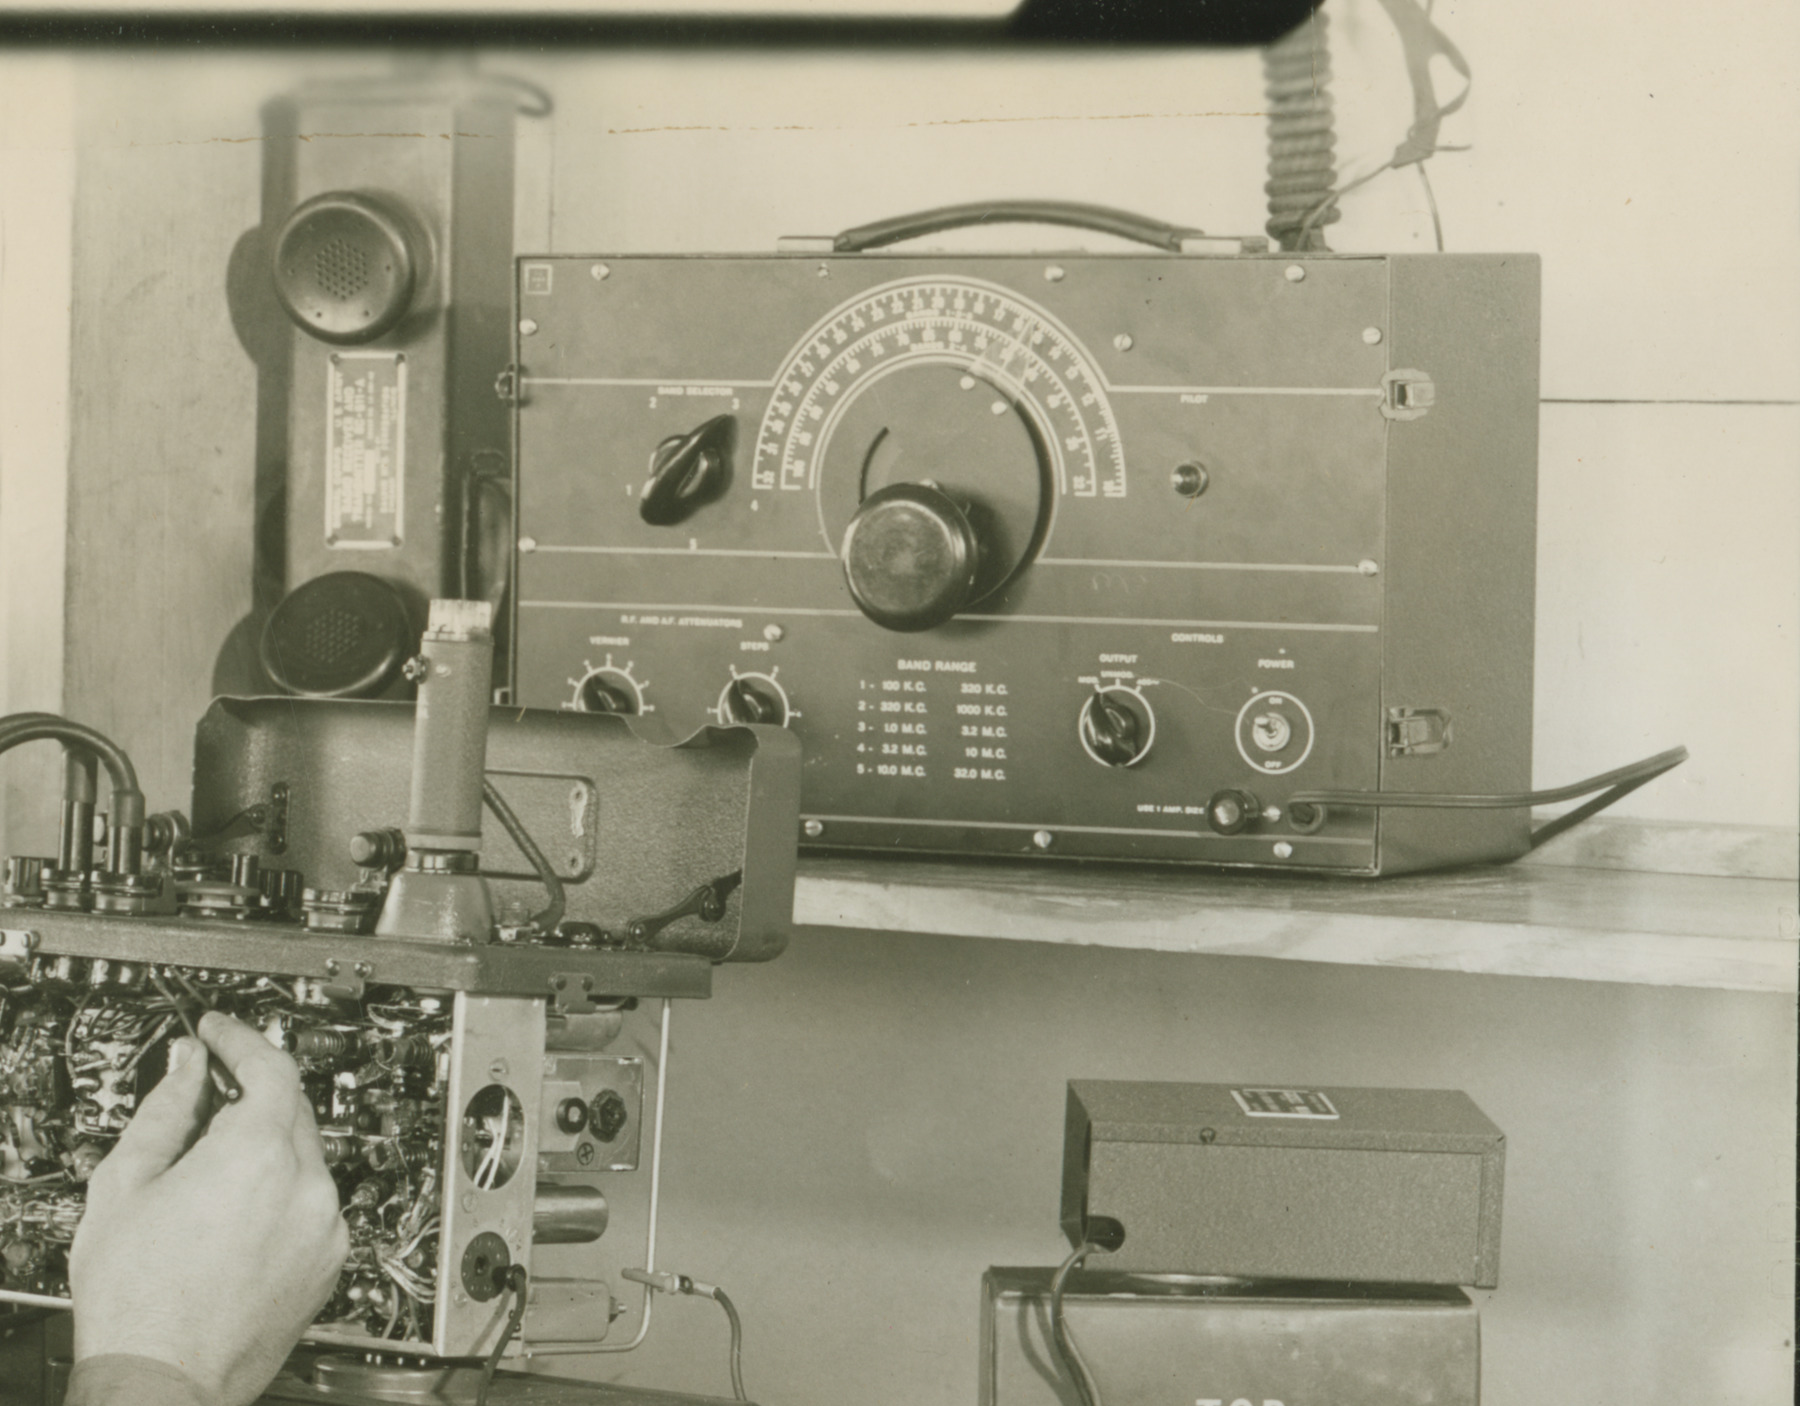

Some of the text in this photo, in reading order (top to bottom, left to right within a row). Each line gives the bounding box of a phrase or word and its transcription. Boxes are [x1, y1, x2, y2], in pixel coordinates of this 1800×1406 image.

[1171, 633, 1224, 644] CONTROLS
[1099, 653, 1138, 664] OUTPUT
[1257, 659, 1295, 669] POWER
[897, 659, 977, 672] BAND RANGE
[961, 683, 982, 694] 320
[880, 701, 901, 712] 320
[957, 704, 981, 715] 1000
